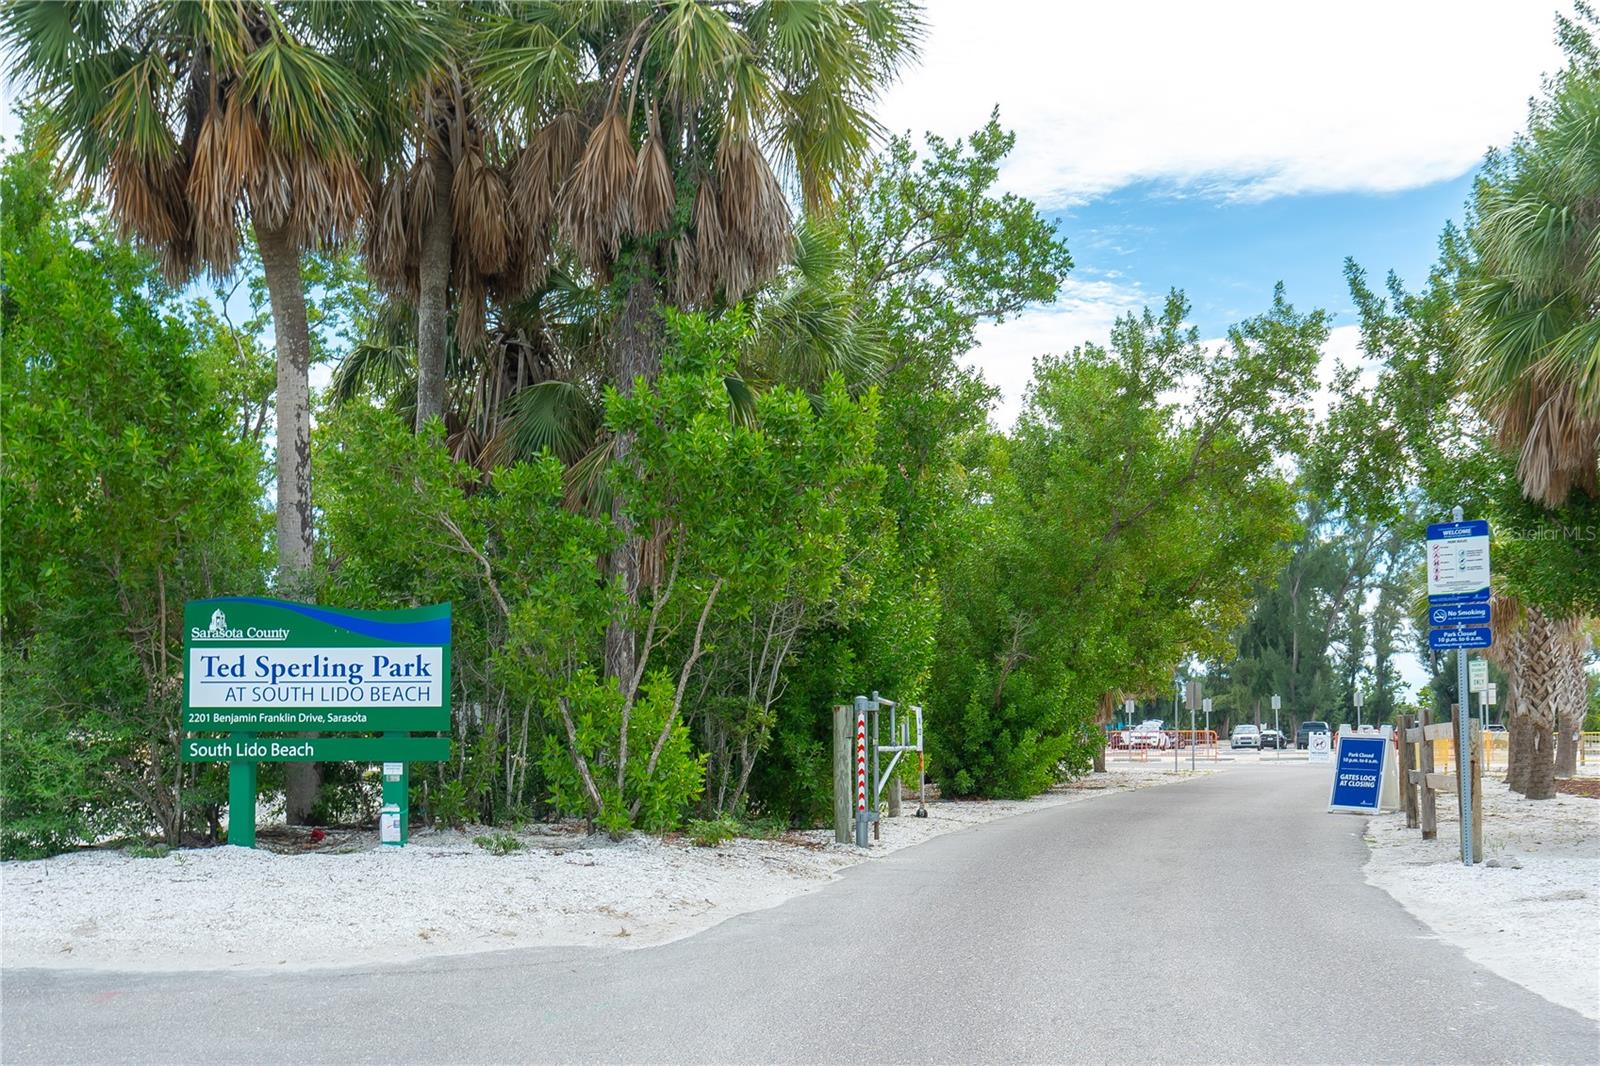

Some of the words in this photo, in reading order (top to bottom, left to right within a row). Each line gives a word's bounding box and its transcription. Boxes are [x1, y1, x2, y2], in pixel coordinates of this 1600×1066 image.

[1443, 528, 1472, 536] WELCOME
[191, 627, 244, 638] Sarasota
[246, 627, 290, 641] County
[200, 654, 246, 678] Ted
[254, 654, 364, 686] Sperling
[371, 654, 433, 678] Park
[225, 686, 247, 702] AT
[251, 686, 314, 702] SOUTH
[320, 686, 364, 702] LIDO
[370, 686, 430, 702] BEACH
[188, 713, 211, 723] 2201
[213, 713, 257, 725] Benjamin
[259, 713, 297, 723] Franklin
[298, 713, 326, 724] Drive,
[327, 713, 367, 723] Sarasota
[189, 742, 232, 757] South
[236, 742, 267, 757] Lido
[271, 742, 314, 757] Beach
